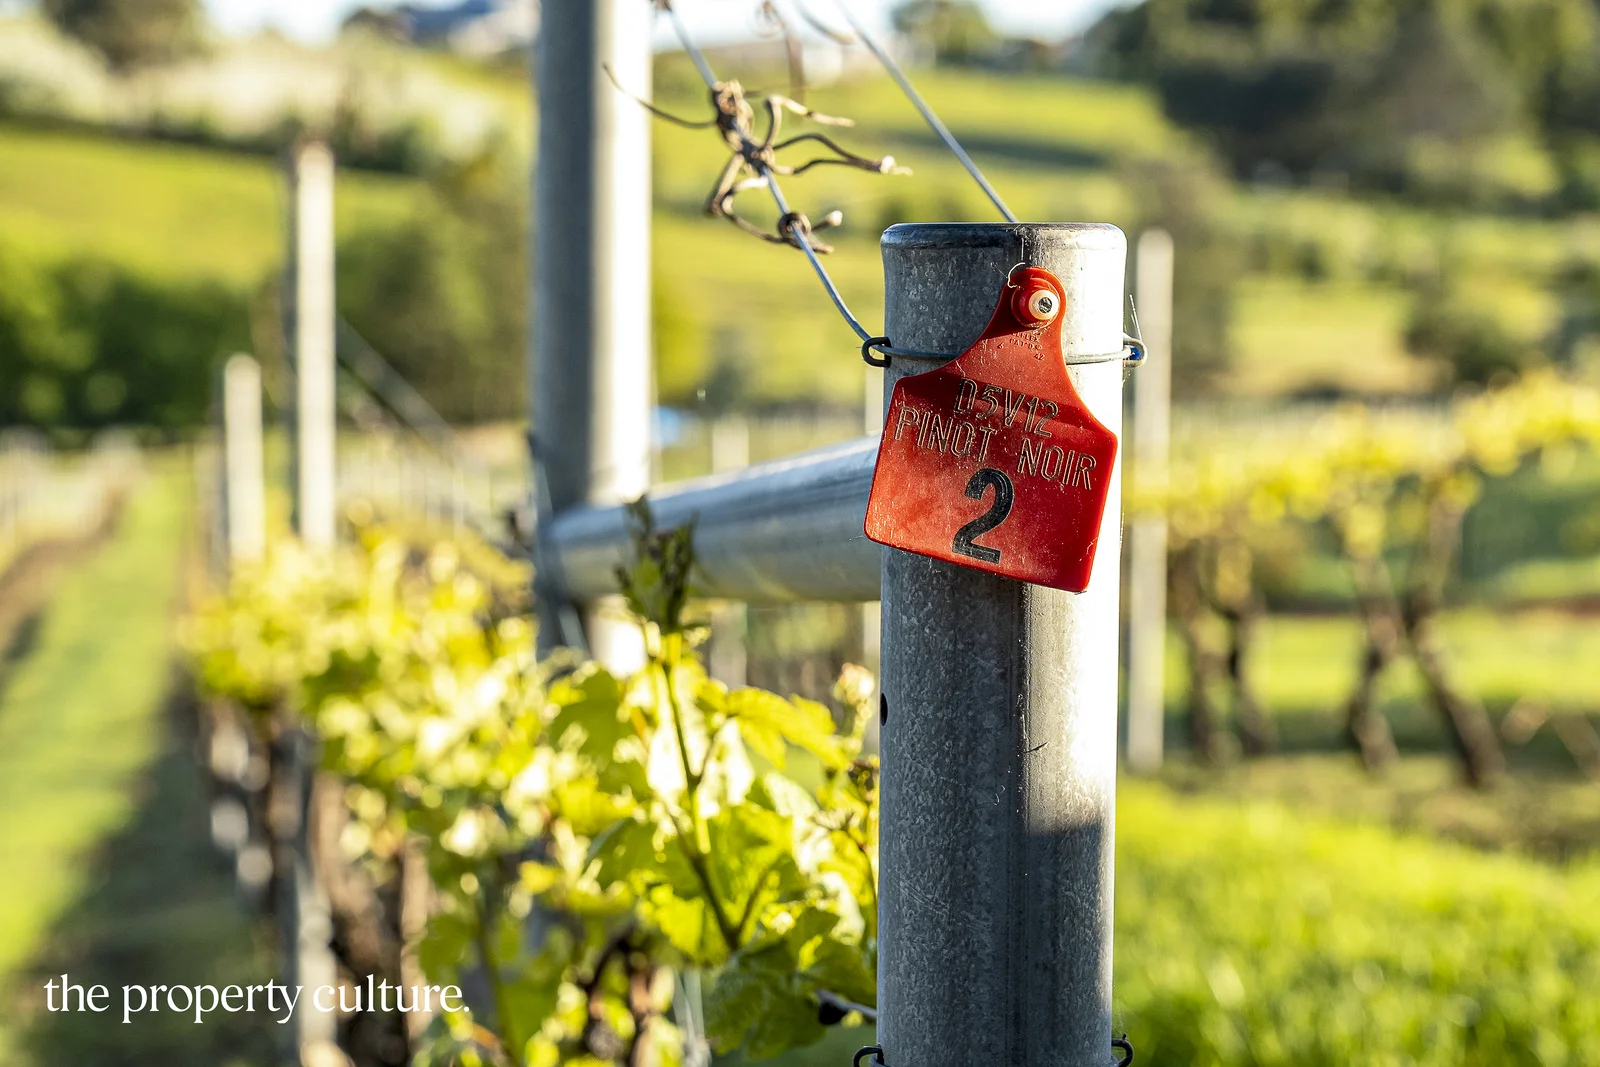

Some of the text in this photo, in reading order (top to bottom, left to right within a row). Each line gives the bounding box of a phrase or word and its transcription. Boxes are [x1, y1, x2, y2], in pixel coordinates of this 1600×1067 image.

[894, 405, 1097, 491] PINOT NOIR
[953, 377, 1058, 438] D5V12
[952, 468, 1015, 564] 2
